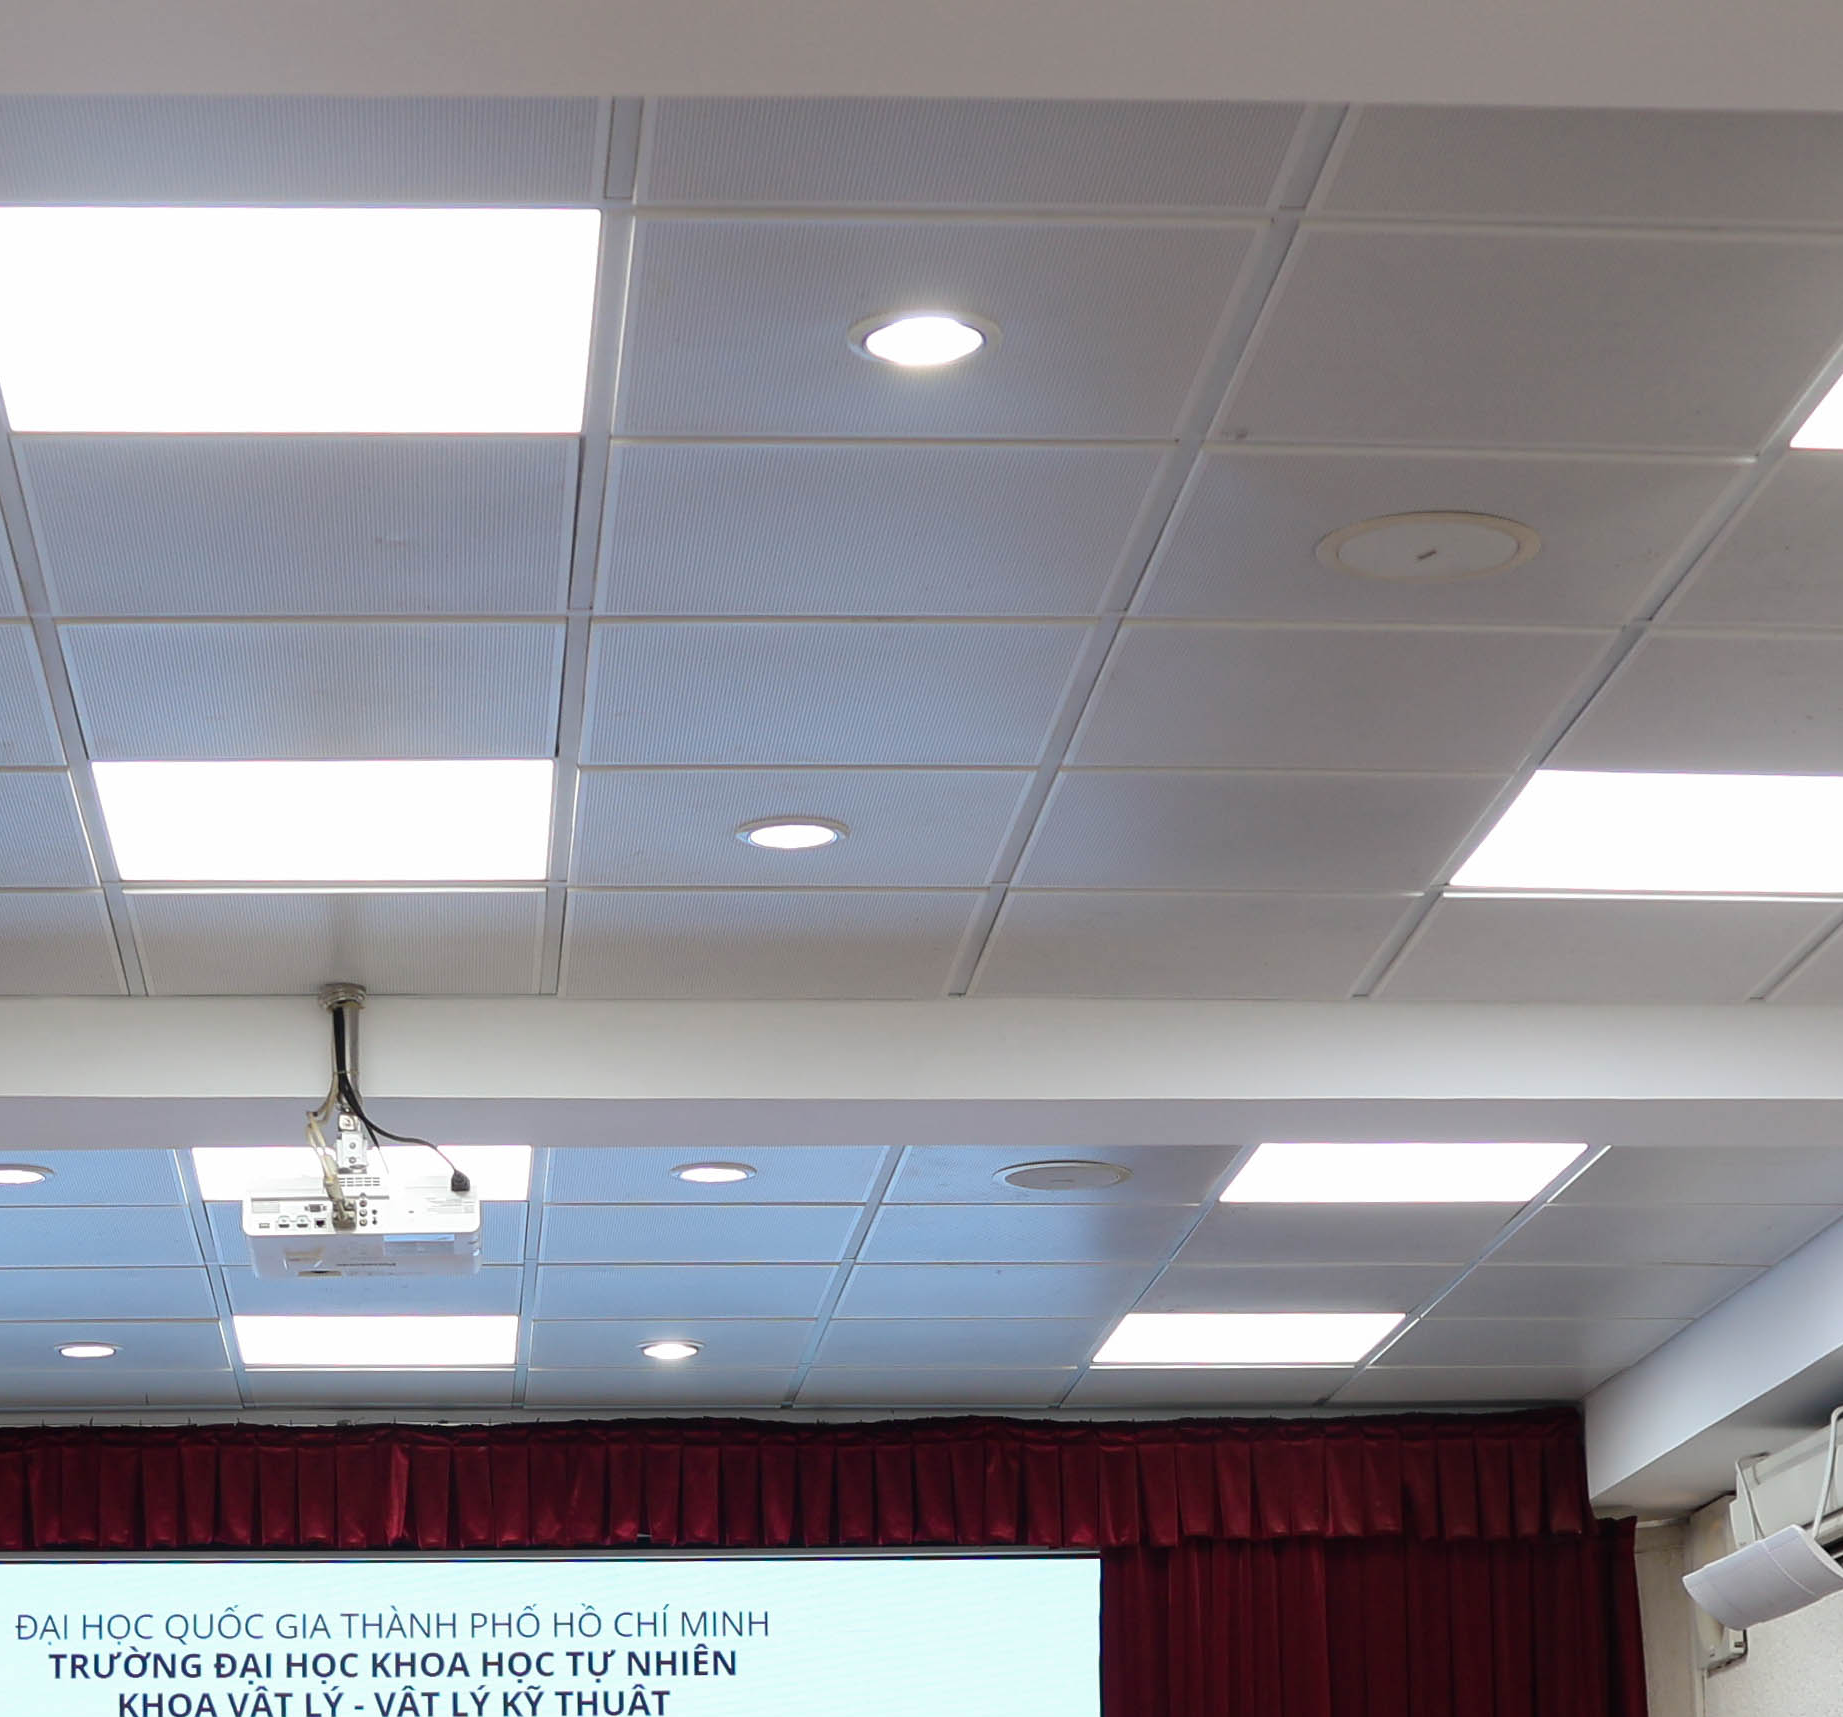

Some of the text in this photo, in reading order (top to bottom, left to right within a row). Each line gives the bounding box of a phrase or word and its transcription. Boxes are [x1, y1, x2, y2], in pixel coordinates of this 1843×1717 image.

[15, 1603, 769, 1646] ĐẠI HỌC QUỐC GIA THÀNH PHỐ HỒ CHÍ MINH
[48, 1643, 737, 1685] TRƯỜNG ĐẠI HỌC KHOA HỌC TỰ NHIÊN
[452, 1684, 491, 1717] LÝ
[503, 1684, 545, 1717] KỸ
